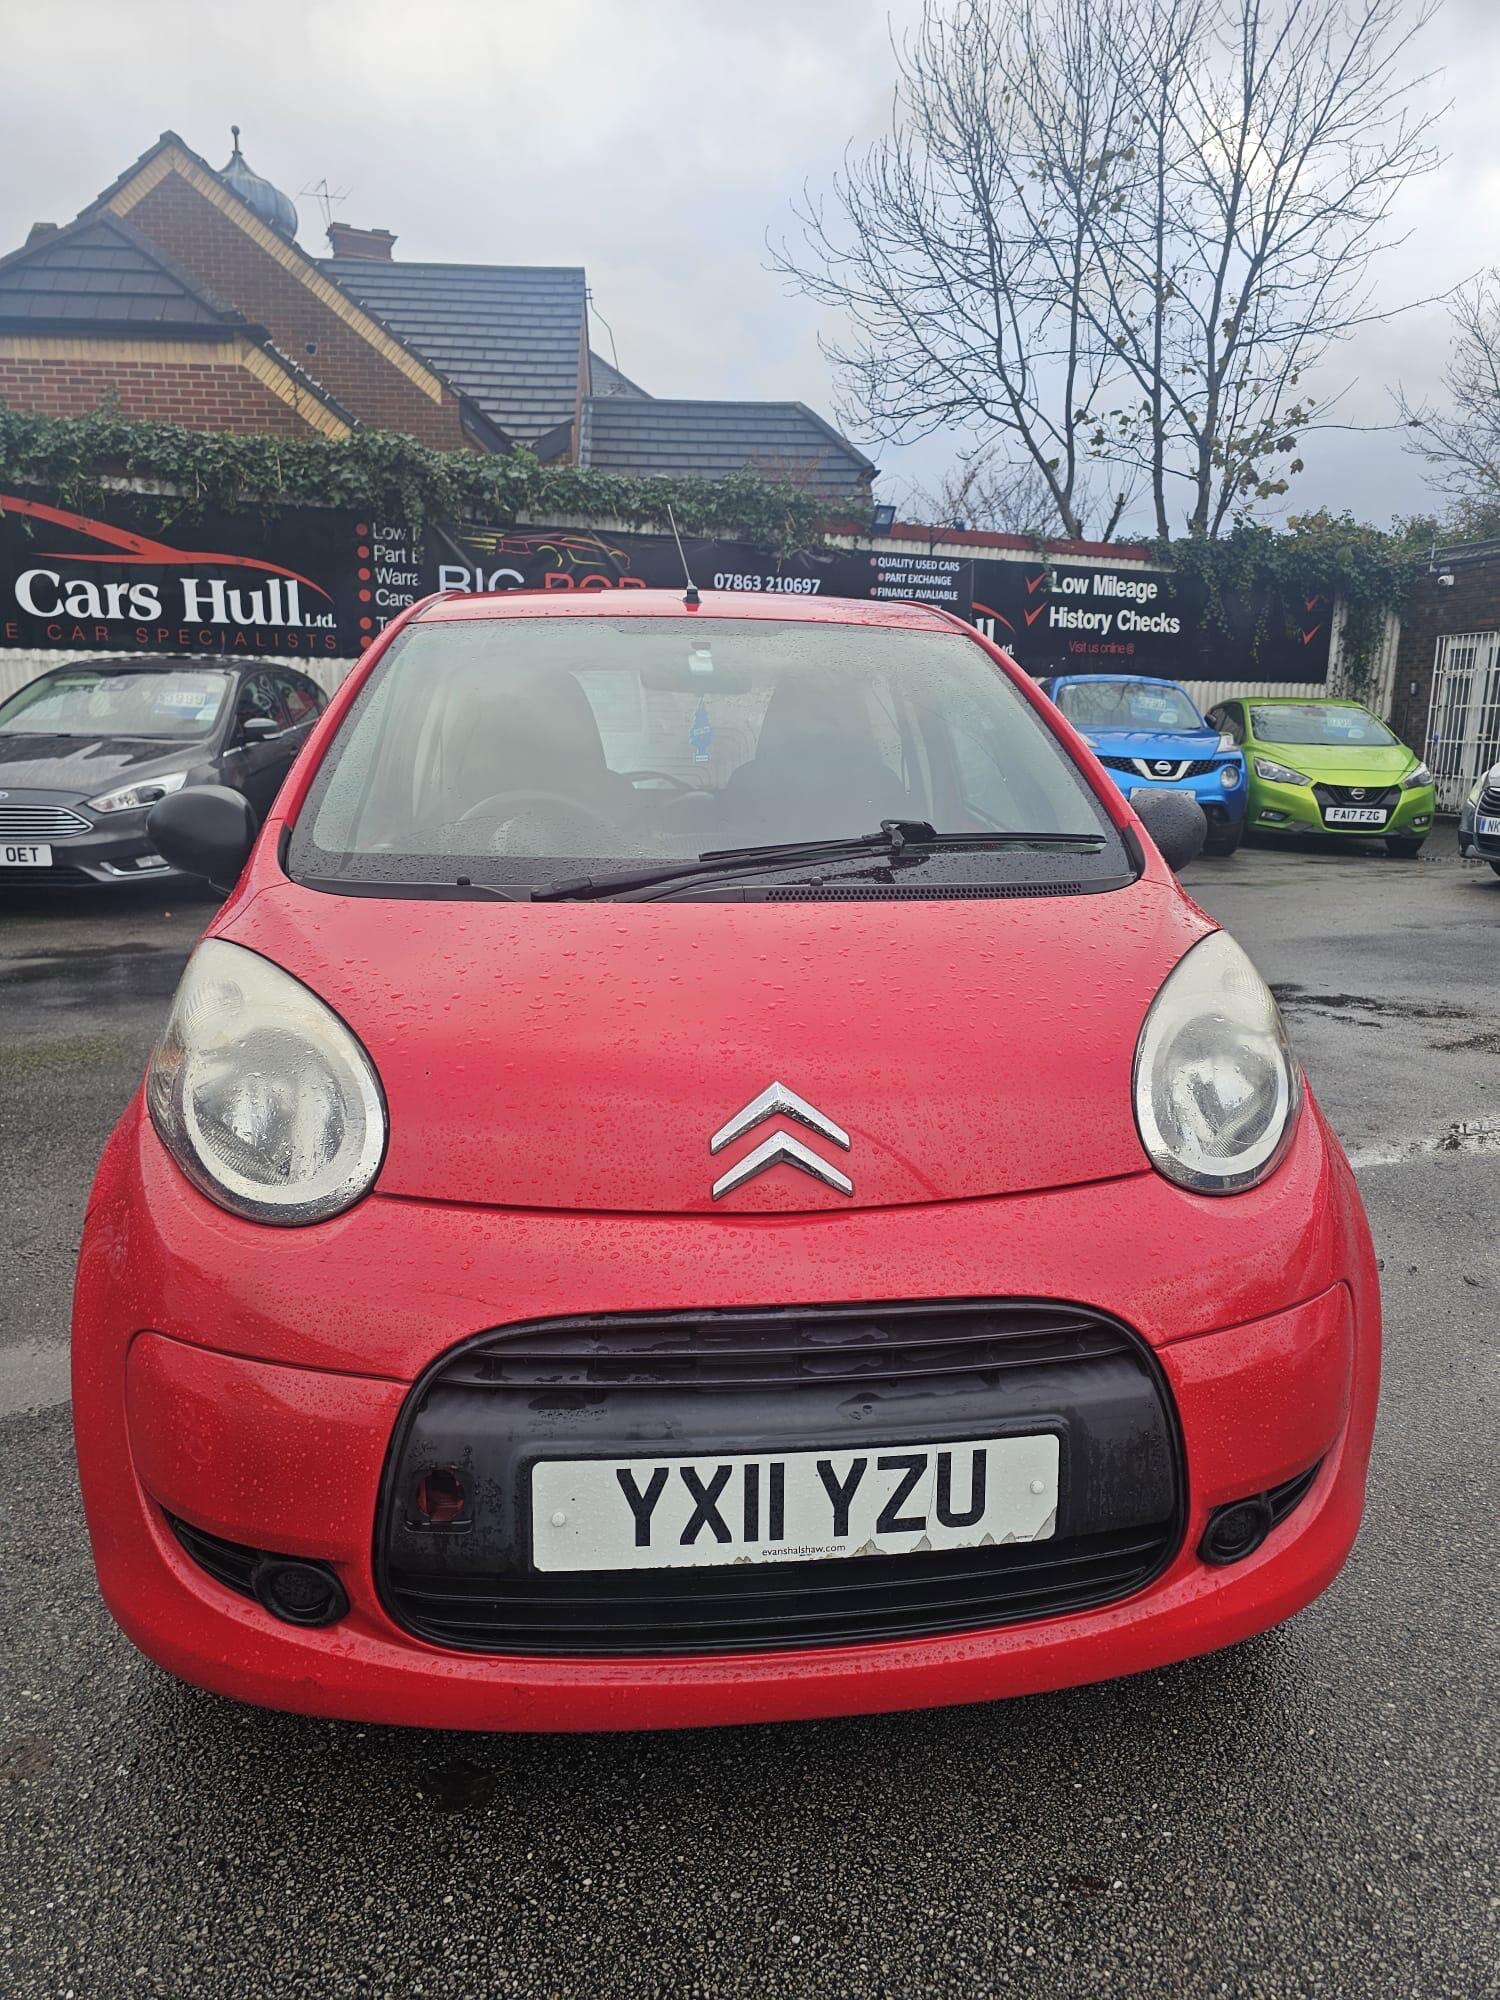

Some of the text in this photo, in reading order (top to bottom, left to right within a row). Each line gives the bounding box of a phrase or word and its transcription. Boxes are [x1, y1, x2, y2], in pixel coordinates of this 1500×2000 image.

[372, 522, 407, 541] Low
[373, 544, 407, 564] Part
[878, 557, 960, 571] QUALITY USED CARS
[713, 573, 821, 594] 07863 210697
[885, 573, 952, 586] PART EXCHANGE
[1051, 571, 1158, 603] Low Mileage
[14, 569, 337, 628] Cars Hull Ltd.
[375, 588, 414, 607] Cars
[877, 587, 958, 600] FINANCE AVALIABLE
[1049, 606, 1181, 635] History Checks
[47, 624, 337, 650] CAR SPECIALISTS
[1069, 640, 1087, 653] Visit
[1333, 809, 1380, 821] FA17 FZG
[5, 847, 39, 862] OET
[615, 1448, 988, 1548] YX11 YZU
[761, 1543, 846, 1557] evanshalshaw.com
